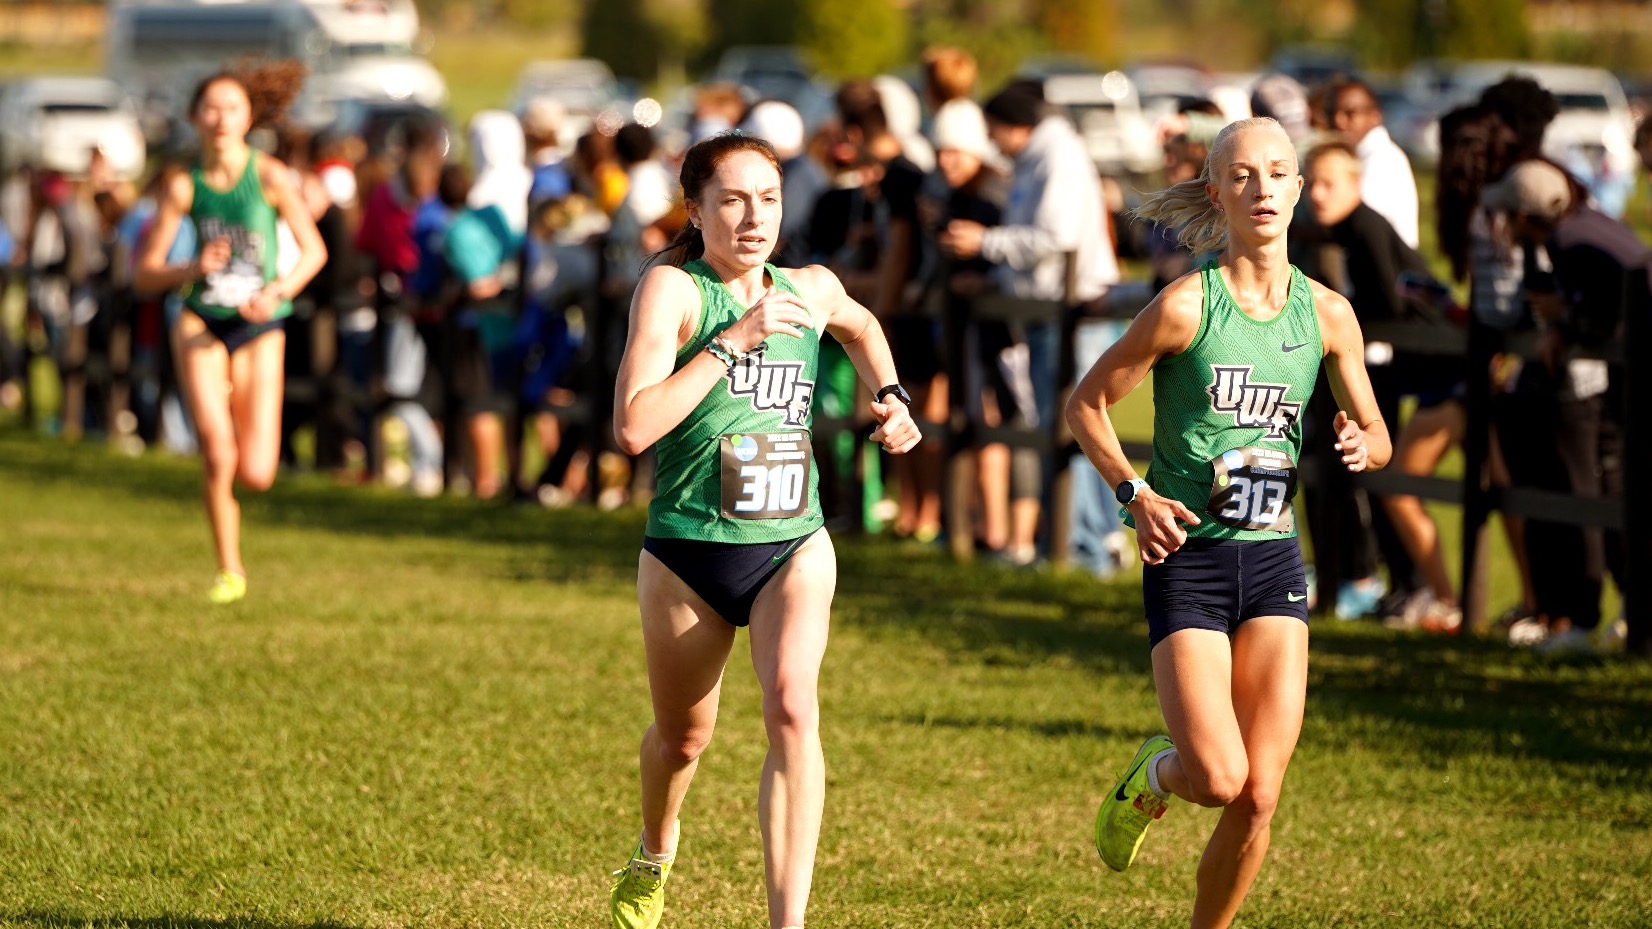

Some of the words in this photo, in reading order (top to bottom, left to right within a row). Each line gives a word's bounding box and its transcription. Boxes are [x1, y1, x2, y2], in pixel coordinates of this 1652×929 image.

[727, 342, 815, 430] UWF
[1205, 364, 1303, 441] UWF
[734, 463, 805, 513] 310
[1220, 475, 1288, 525] 313
